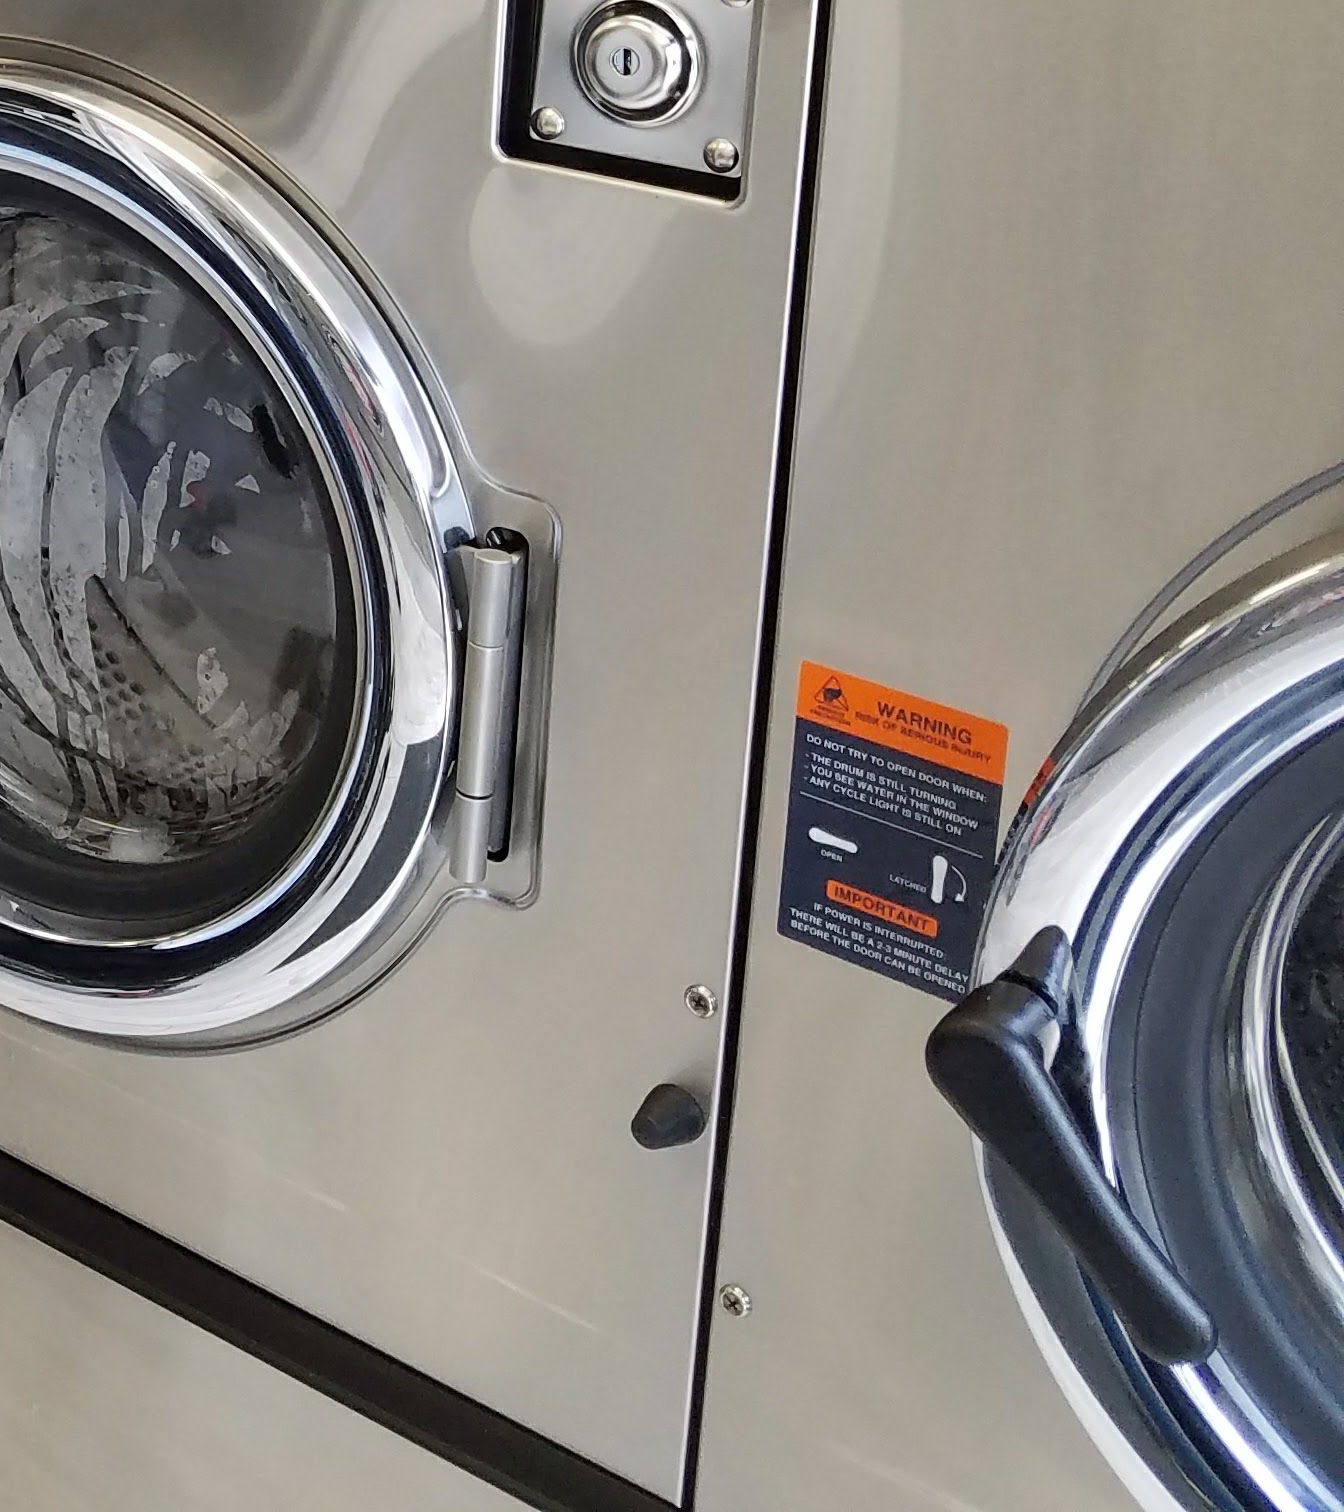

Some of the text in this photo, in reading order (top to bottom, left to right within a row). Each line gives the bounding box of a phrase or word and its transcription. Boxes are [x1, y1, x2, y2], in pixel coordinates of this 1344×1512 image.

[877, 700, 973, 746] WARNING
[806, 733, 950, 792] DO NOT TRY TO OPEN DOOR
[811, 752, 907, 792] THE DRUM STILL
[808, 775, 963, 837] ANY CYCLE LIGHT ON
[811, 765, 979, 830] YOU WINDOW
[814, 902, 823, 912] IF
[824, 906, 861, 927] POWER
[862, 921, 873, 931] IS
[834, 885, 931, 931] IMPORTANT
[790, 907, 969, 983] THERE WILL A 2-3 MINUTE DELAY
[790, 919, 906, 971] BEFORE THE DOOR CAN
